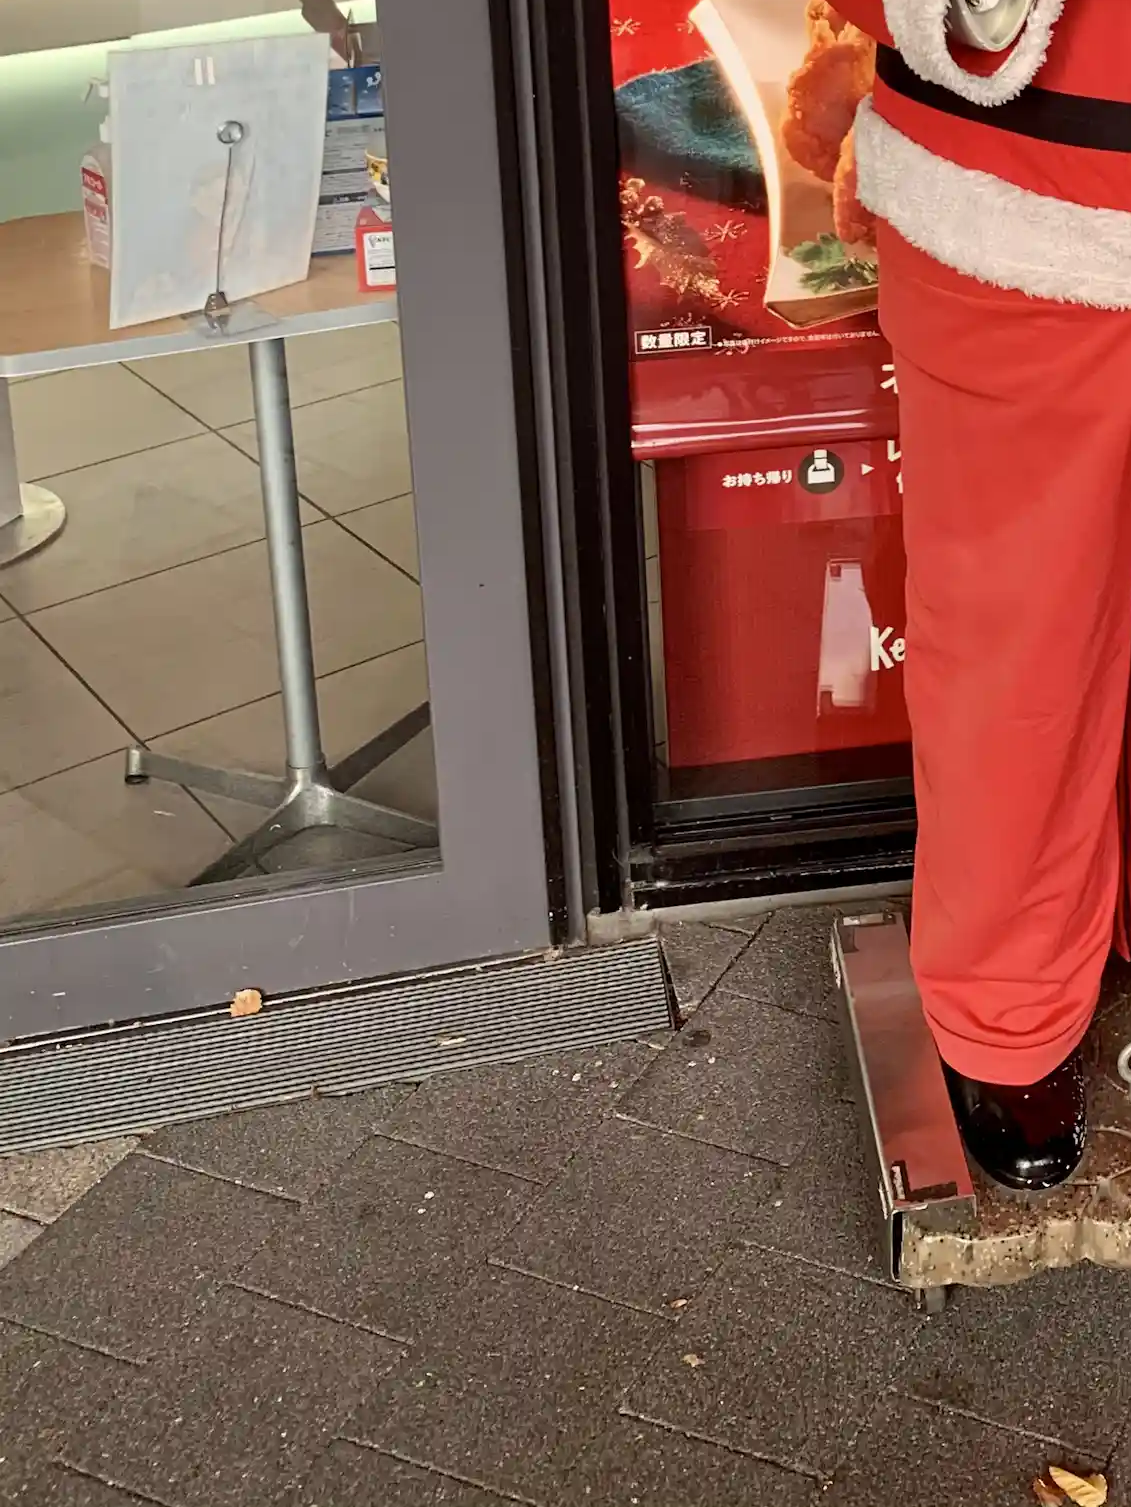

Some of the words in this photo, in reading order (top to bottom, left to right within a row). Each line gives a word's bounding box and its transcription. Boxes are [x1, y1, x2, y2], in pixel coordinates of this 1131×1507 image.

[640, 331, 707, 350] 数量限定
[722, 469, 793, 488] お持ち帰り
